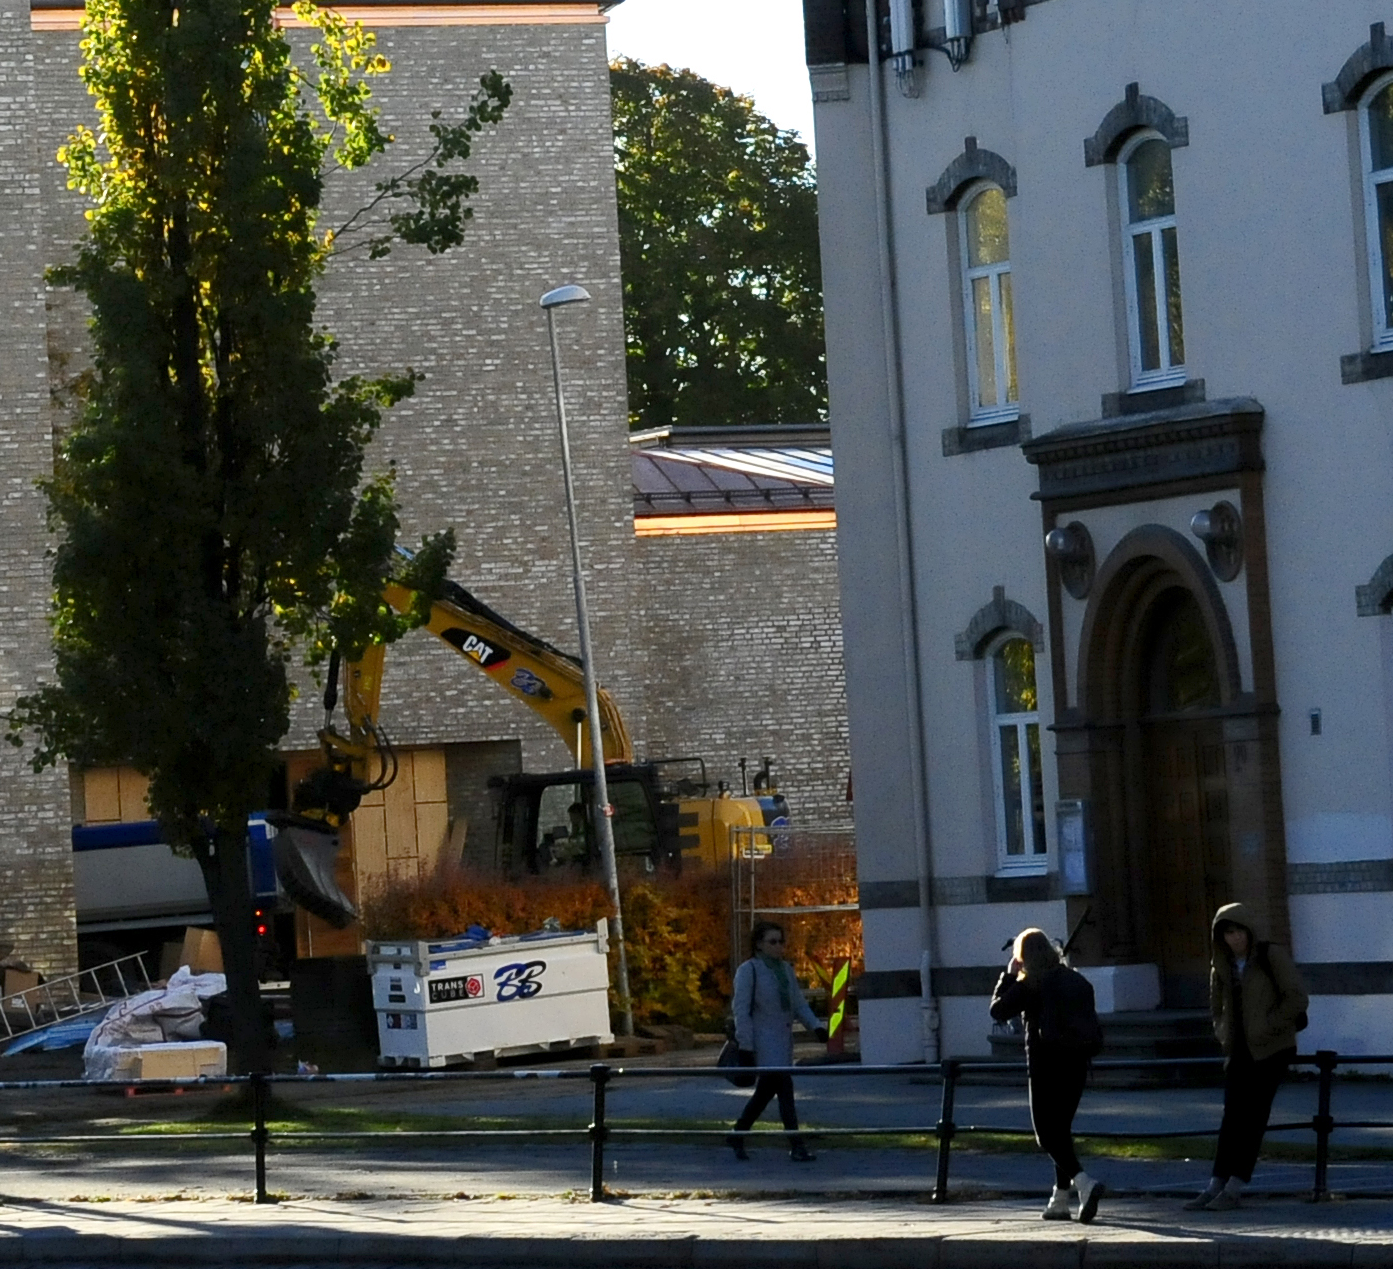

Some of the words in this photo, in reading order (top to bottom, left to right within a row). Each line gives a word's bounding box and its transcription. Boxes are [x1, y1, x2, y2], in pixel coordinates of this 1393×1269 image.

[462, 635, 494, 664] CAT
[431, 979, 464, 992] TRANS
[431, 989, 465, 1001] CUBE
